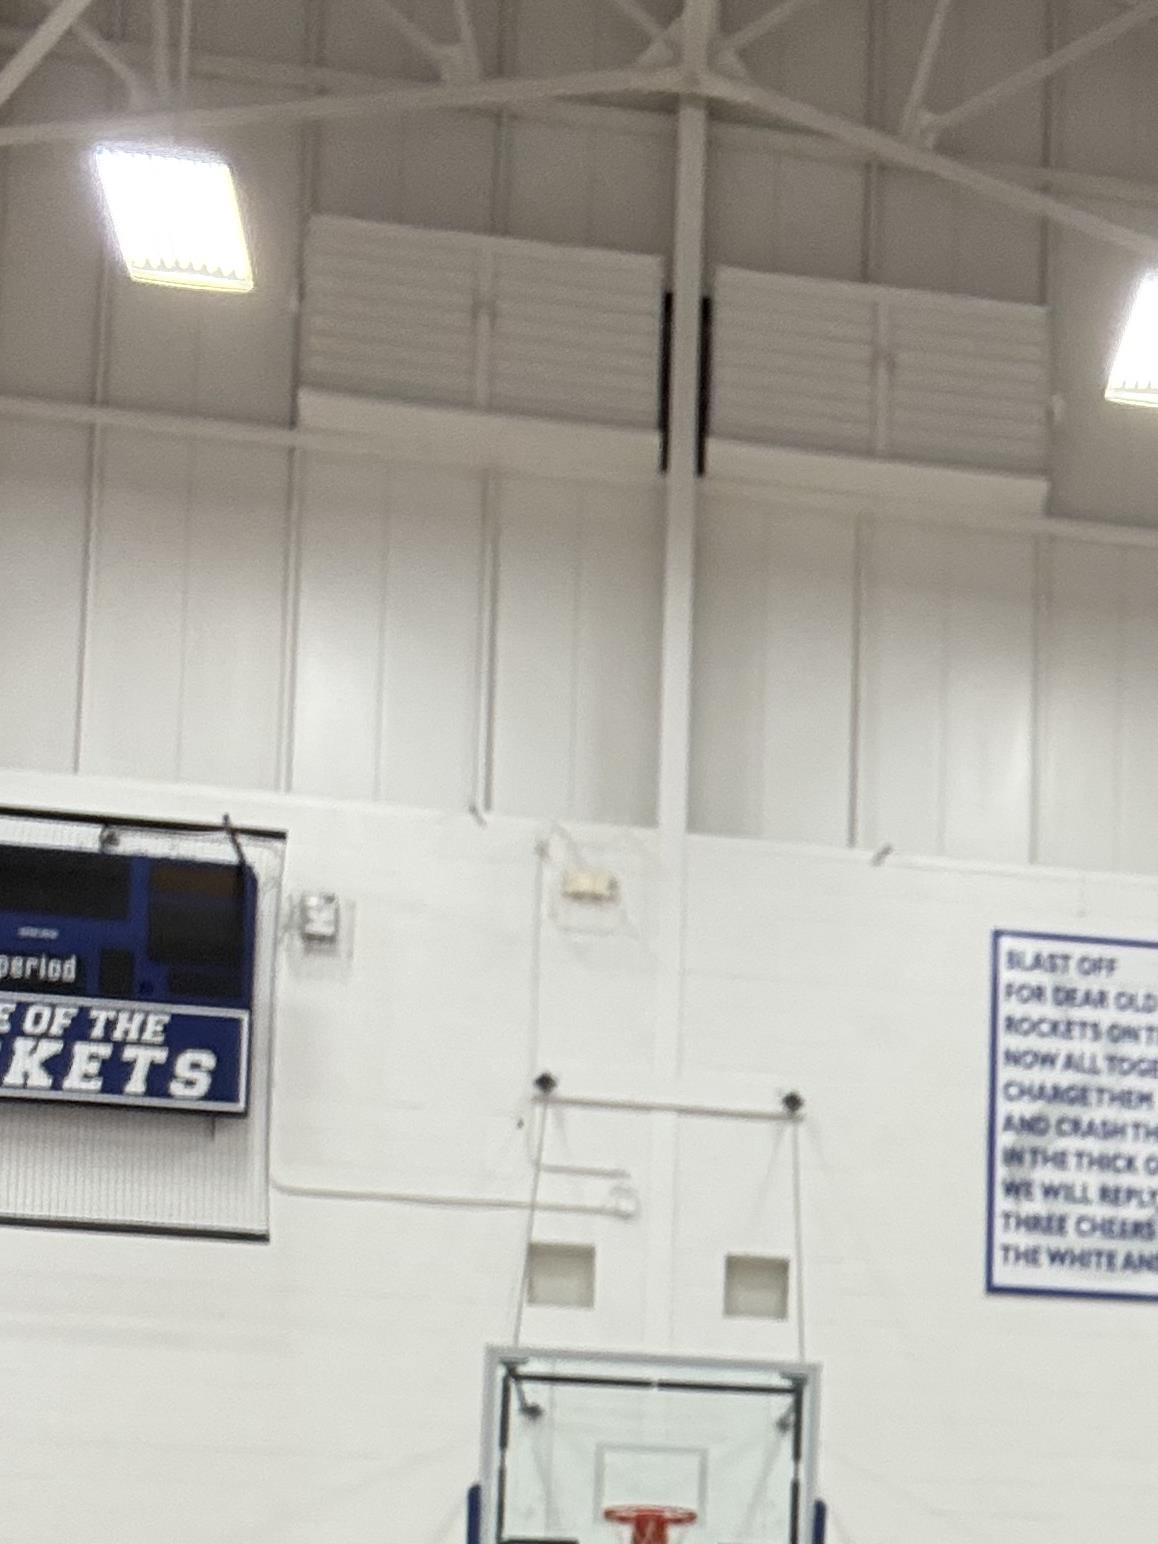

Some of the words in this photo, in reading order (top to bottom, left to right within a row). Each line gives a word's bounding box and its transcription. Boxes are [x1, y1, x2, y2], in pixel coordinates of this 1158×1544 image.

[1006, 951, 1070, 974] BLAST
[1077, 957, 1117, 977] OFF
[1005, 983, 1046, 1004] FOR
[1052, 986, 1109, 1008] DEAR
[1114, 991, 1158, 1014] OLD
[23, 1005, 78, 1037] OF
[89, 1009, 171, 1045] THE
[1005, 1016, 1102, 1041] ROCKETS
[1106, 1023, 1140, 1044] ON
[1004, 1049, 1057, 1068] NOW
[1062, 1053, 1102, 1075] ALL
[1003, 1081, 1090, 1106] CHARGE
[1095, 1087, 1154, 1109] THEM
[1003, 1115, 1050, 1136] AND
[1055, 1116, 1126, 1140] CRASH
[1003, 1148, 1025, 1167] IN
[1029, 1149, 1068, 1171] THE
[1075, 1152, 1137, 1173] THICK
[1003, 1180, 1033, 1200] WE
[1041, 1183, 1091, 1204] WILL
[1002, 1211, 1067, 1236] THREE
[1075, 1216, 1156, 1241] CHEERS
[1001, 1245, 1041, 1267] THE
[1048, 1249, 1117, 1272] WHITE
